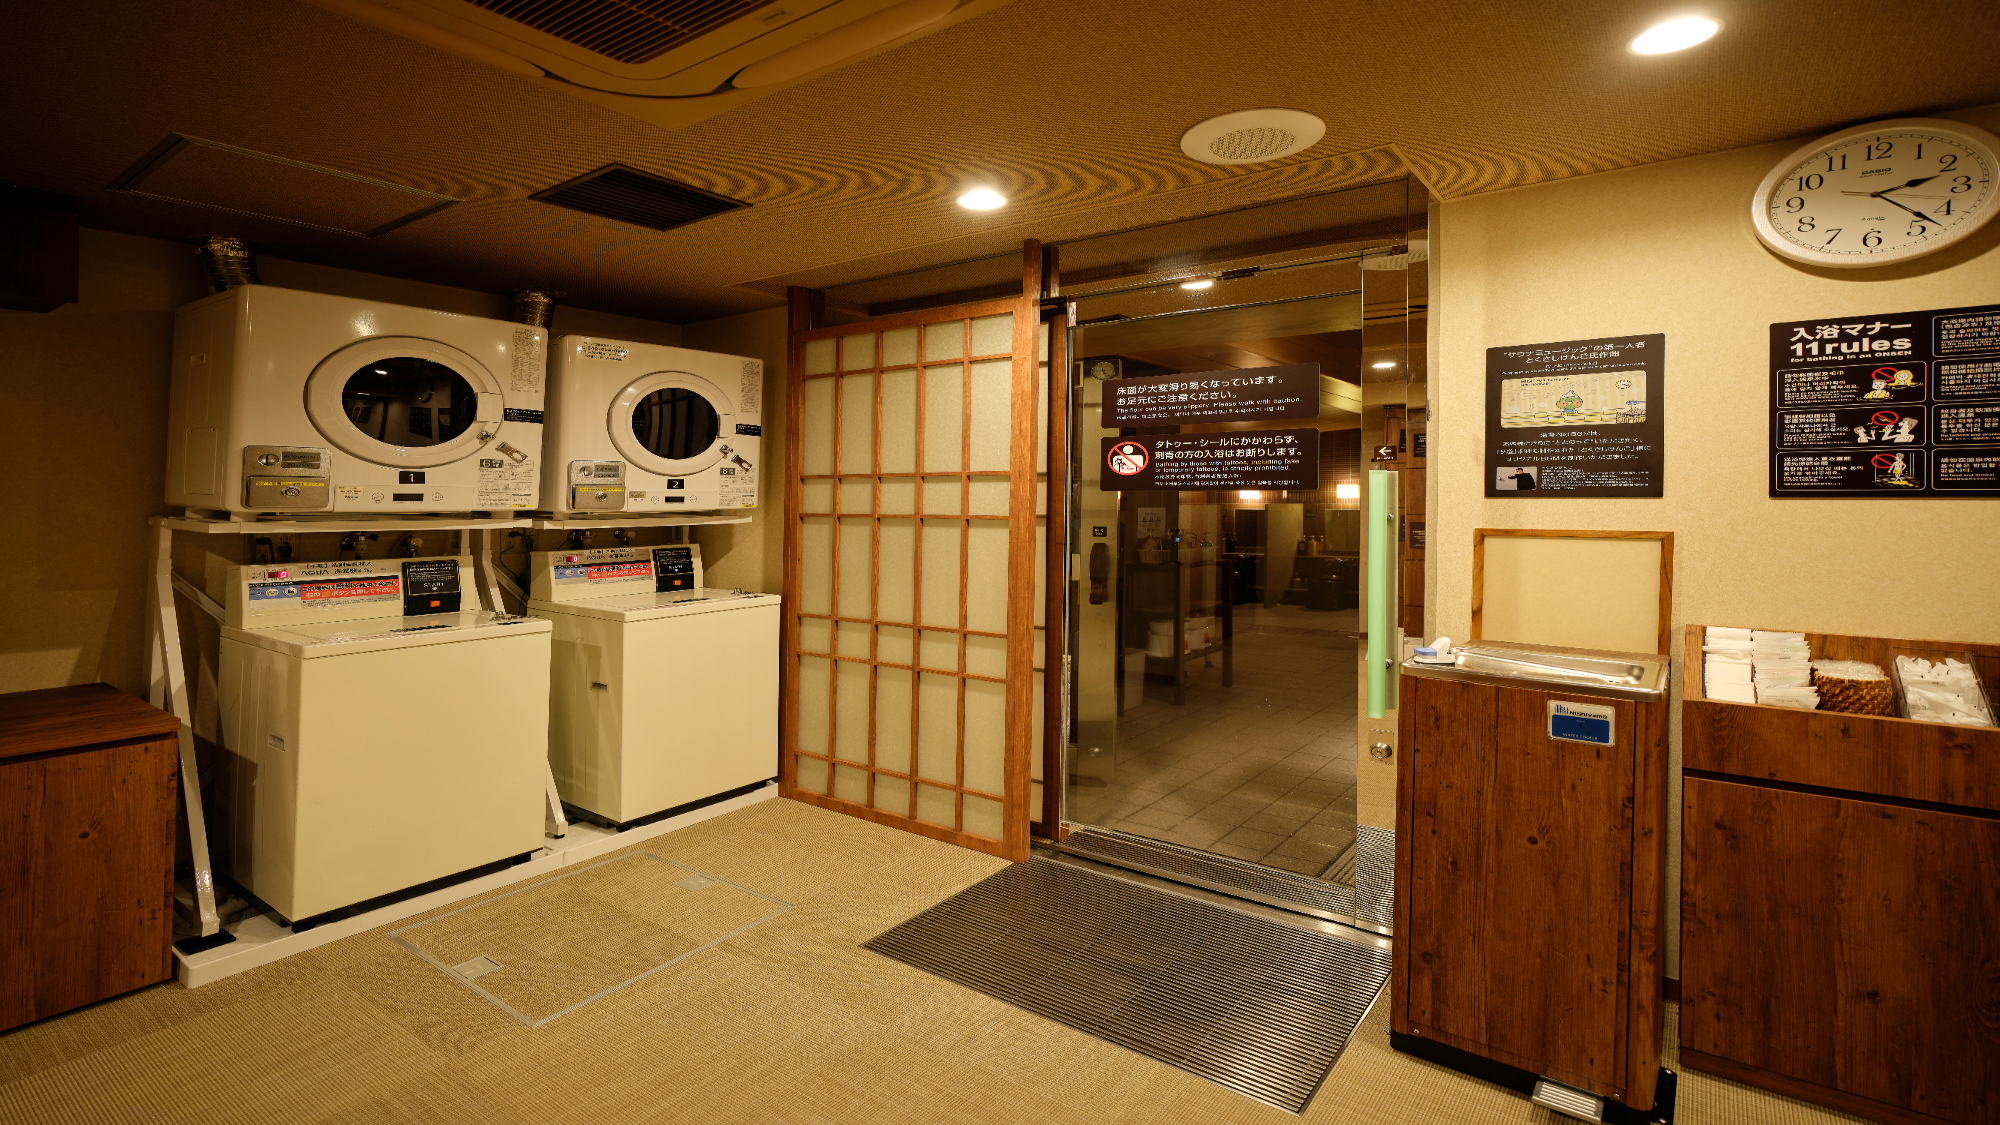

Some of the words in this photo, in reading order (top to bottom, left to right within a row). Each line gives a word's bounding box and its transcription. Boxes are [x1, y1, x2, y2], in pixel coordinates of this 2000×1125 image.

[1864, 142, 1893, 161] 12
[1914, 143, 1923, 160] 1
[1826, 154, 1847, 173] 11
[1939, 154, 1958, 172] 2
[1797, 173, 1824, 192] 10
[1950, 176, 1972, 193] 3
[1786, 197, 1805, 213] 9
[1934, 199, 1955, 216] 4
[1797, 216, 1815, 233] 8
[1906, 220, 1926, 236] 5
[1824, 228, 1842, 245] 7
[1862, 230, 1882, 247] 6
[1790, 321, 1912, 342] 入浴マナー
[1790, 341, 1819, 356] 11
[1825, 337, 1912, 354] rules
[1116, 375, 1283, 395] 床面が大変滑り易くなっています。
[1116, 391, 1237, 405] お足元にご注意ください。
[1155, 435, 1299, 449] タトゥー・シールにかかわらず、
[1154, 448, 1302, 460] 刺青の方の入浴はお断りします。
[408, 473, 414, 482] 1
[1569, 711, 1608, 719] Nishiyama
